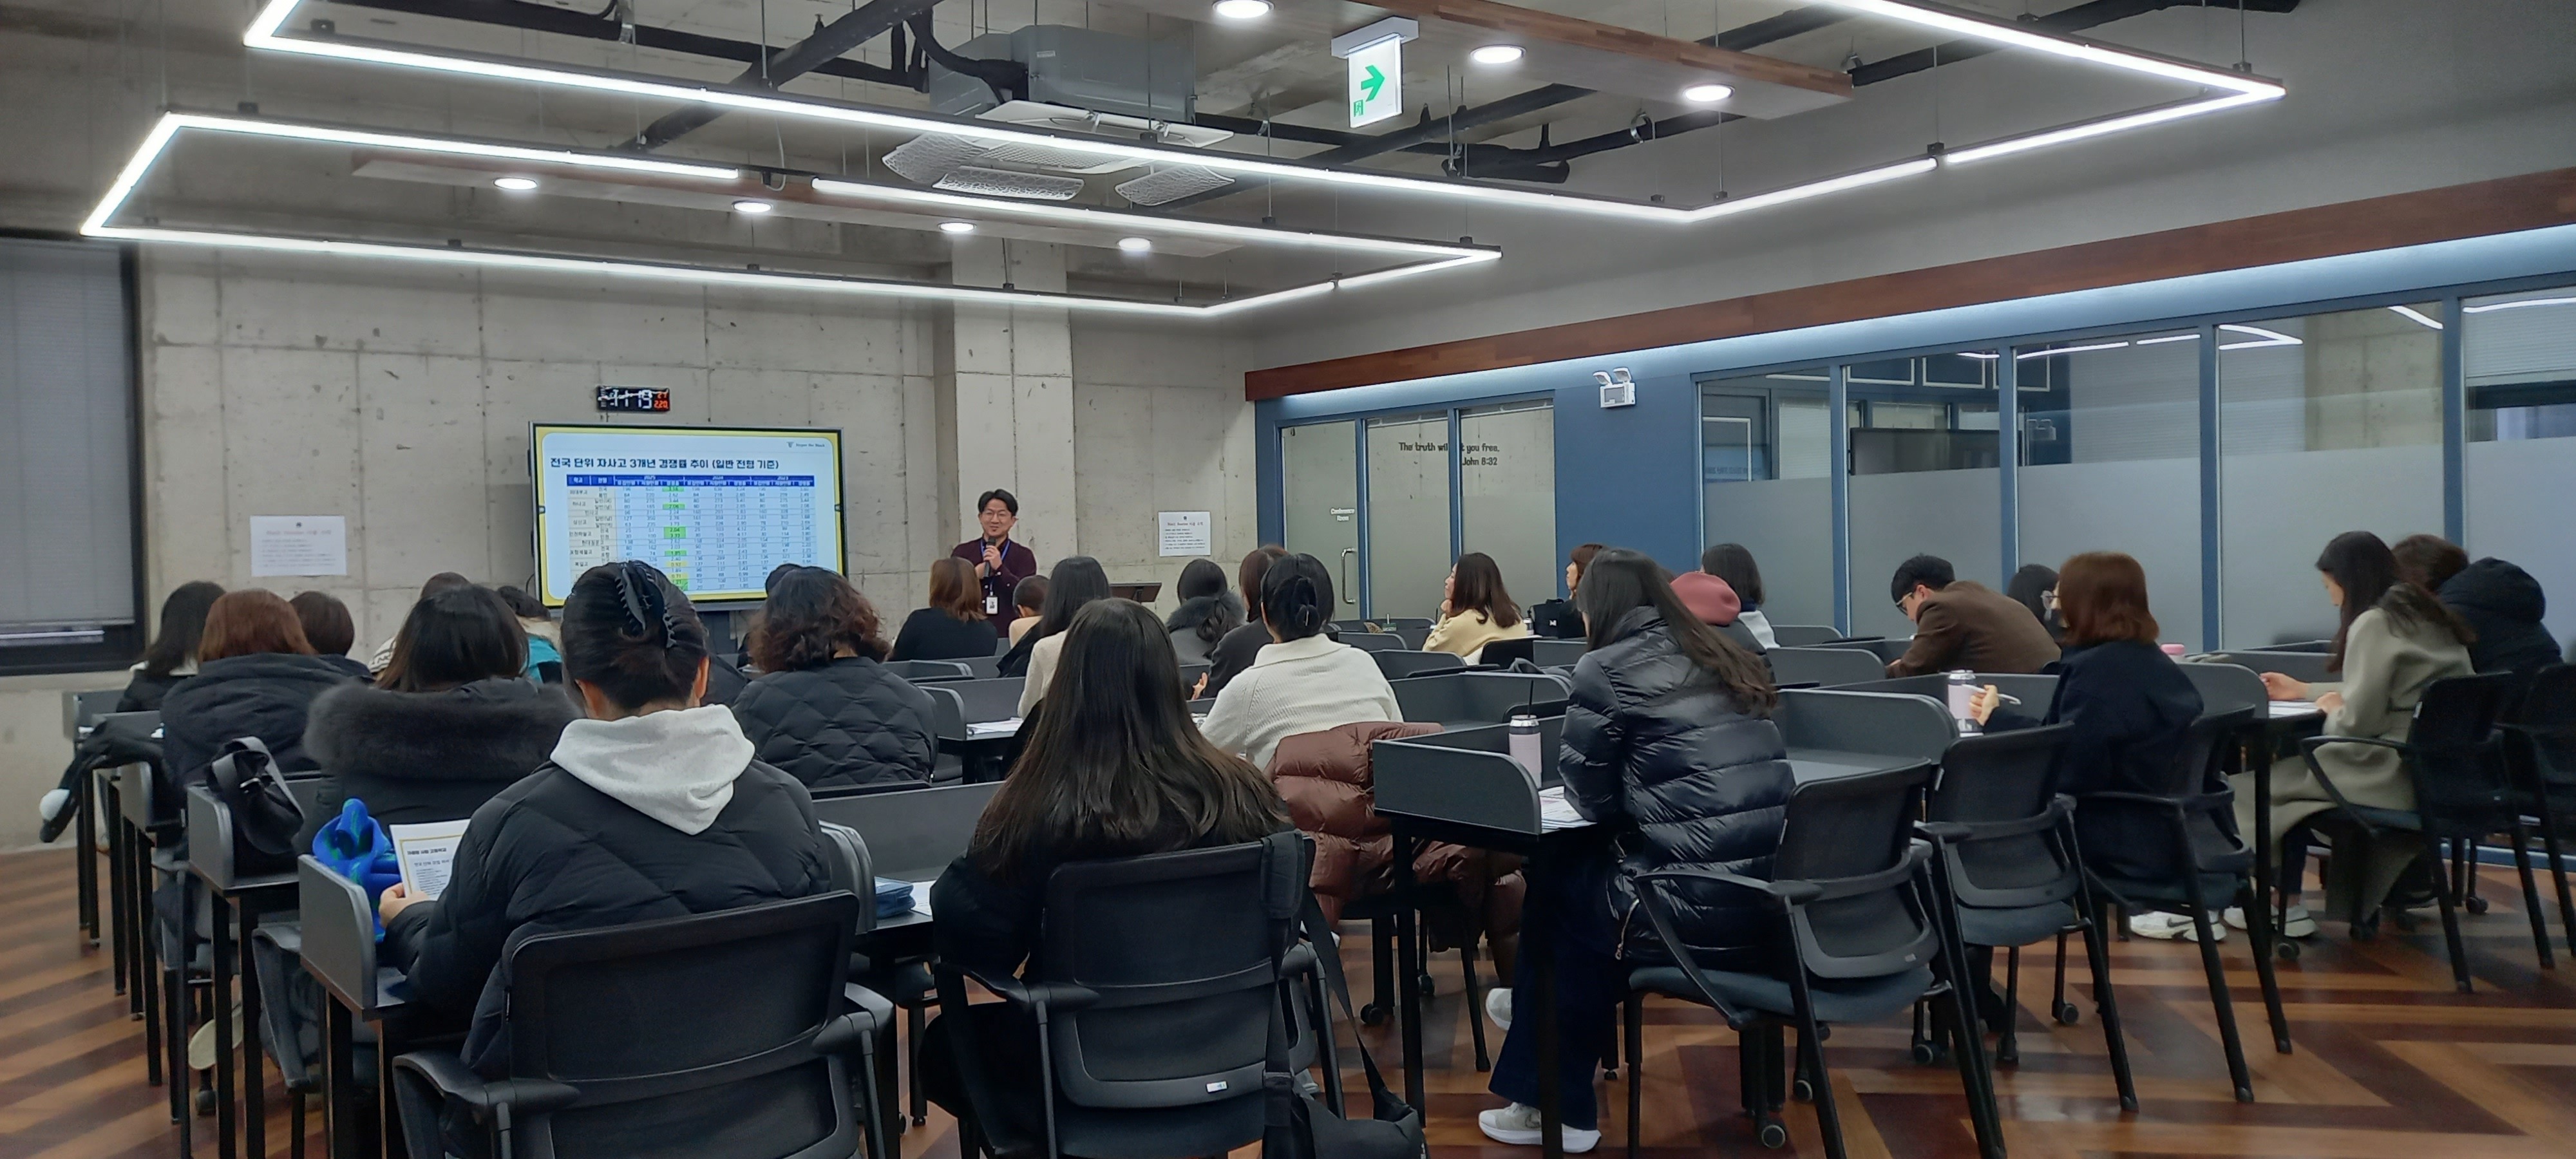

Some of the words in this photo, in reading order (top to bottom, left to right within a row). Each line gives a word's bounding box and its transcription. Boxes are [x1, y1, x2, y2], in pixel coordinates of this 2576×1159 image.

[1399, 442, 1414, 451] The
[1415, 442, 1435, 451] truth
[1437, 442, 1448, 451] wil
[1467, 445, 1479, 454] you
[1482, 443, 1499, 452] free.
[551, 458, 571, 467] 전국
[574, 458, 594, 467] 단위
[597, 458, 627, 467] 자사고
[630, 458, 656, 468] 3개년
[659, 459, 687, 468] 경쟁률
[690, 459, 708, 468] 추이
[712, 459, 734, 469] (일반
[737, 460, 754, 469] 전형
[757, 460, 779, 469] 기준)
[1462, 457, 1479, 466] John
[1481, 457, 1497, 466] 8:32
